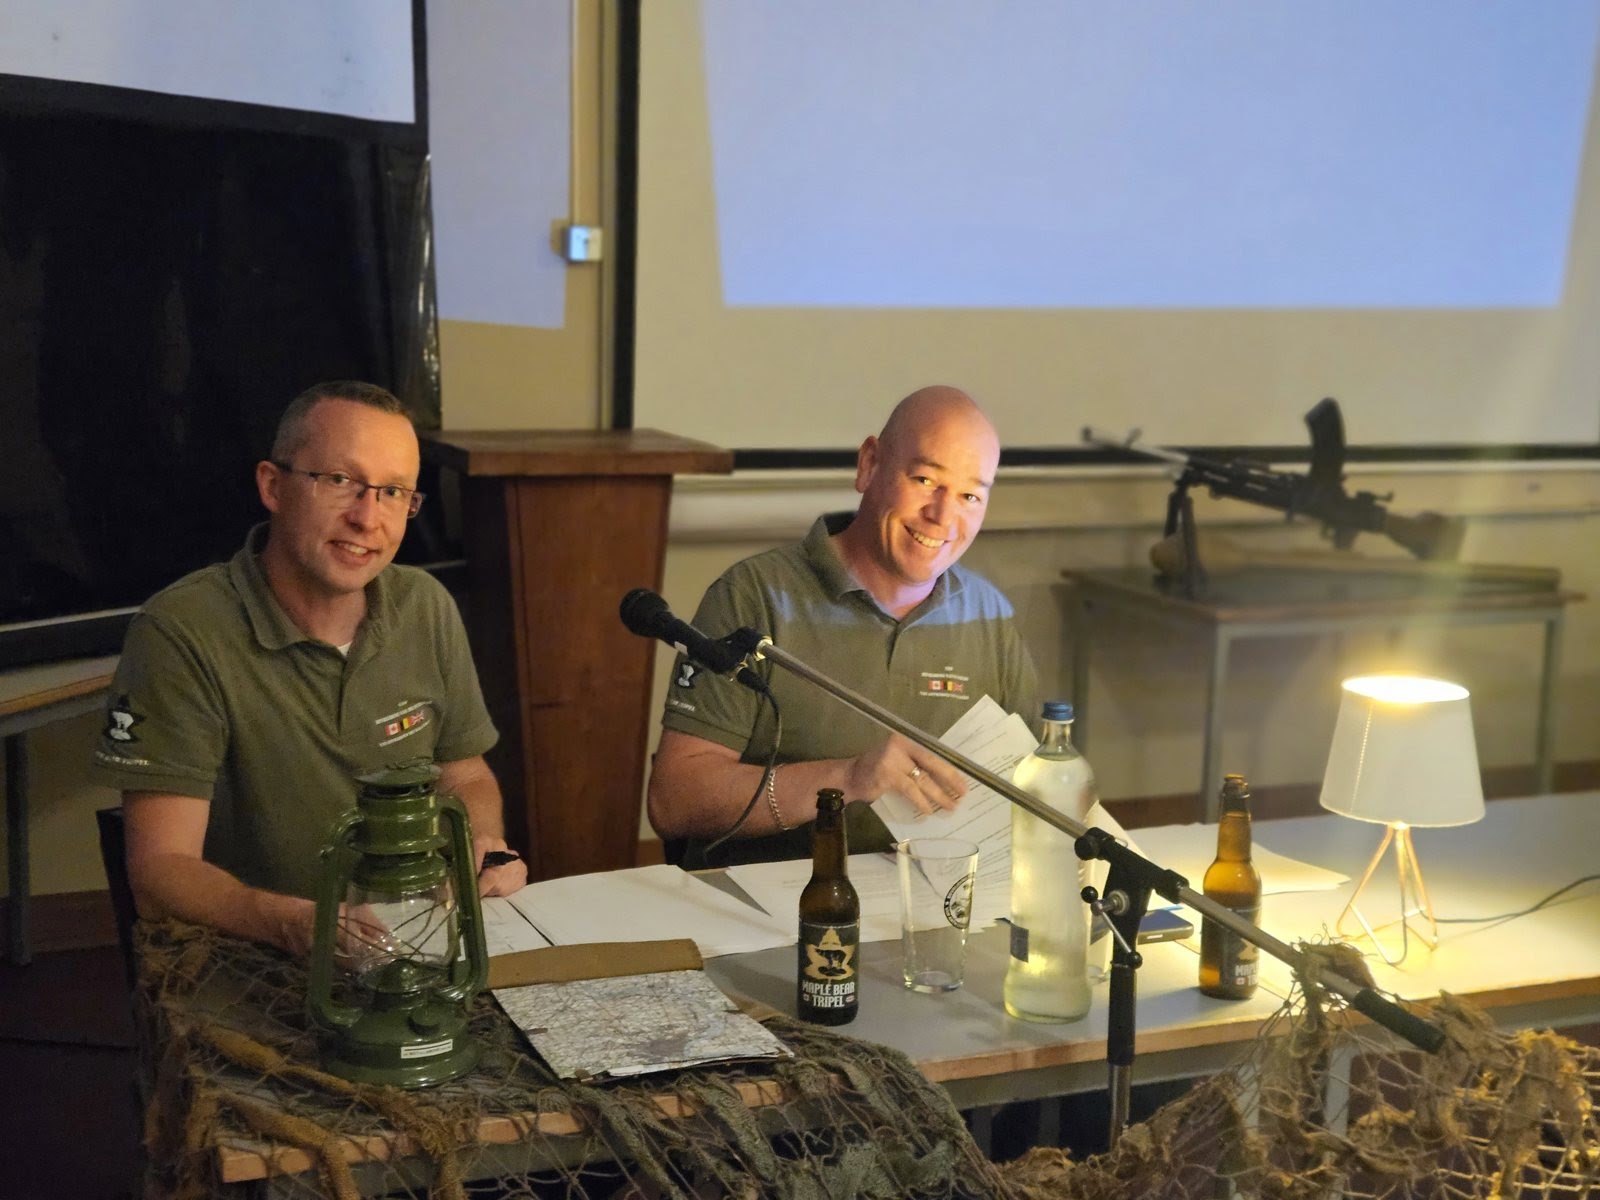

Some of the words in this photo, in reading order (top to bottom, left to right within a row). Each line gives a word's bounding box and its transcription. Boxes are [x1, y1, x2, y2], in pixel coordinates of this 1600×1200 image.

[802, 981, 831, 995] MAPLE
[833, 982, 855, 995] BEAR
[813, 995, 845, 1007] TRIPEL
